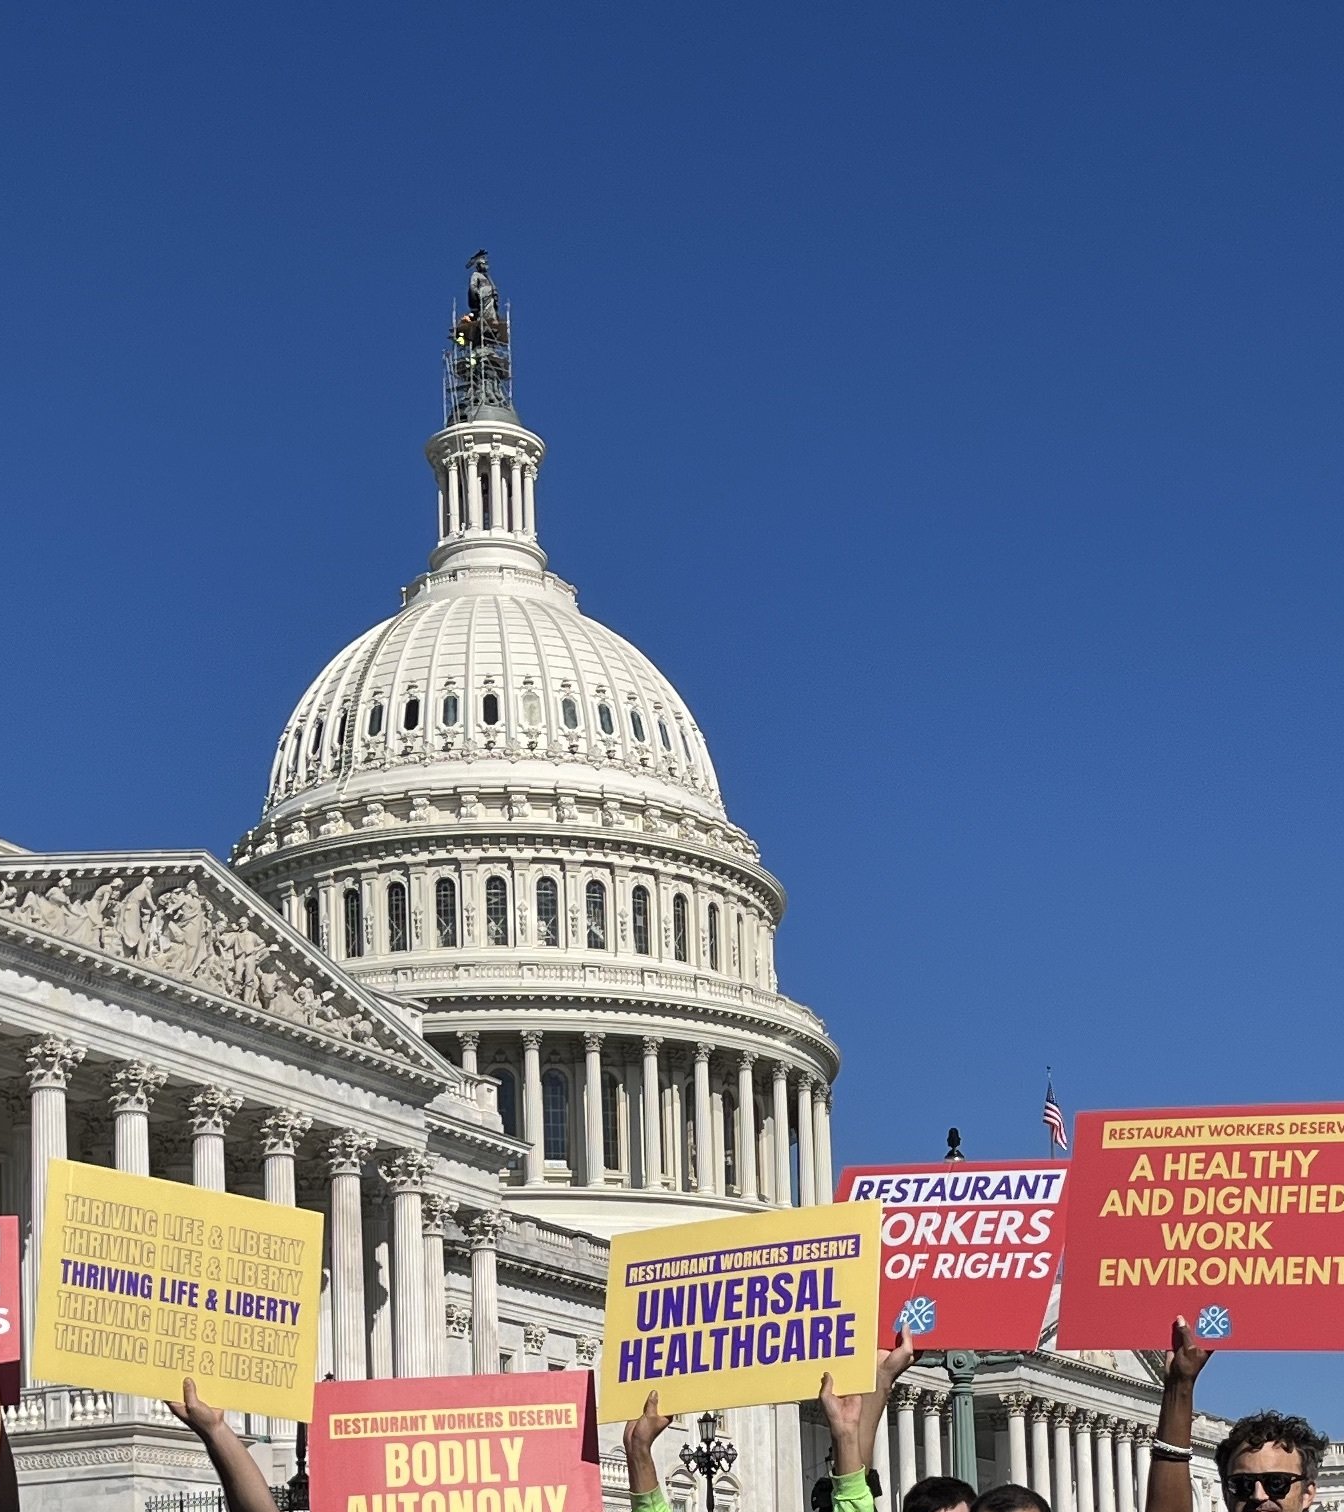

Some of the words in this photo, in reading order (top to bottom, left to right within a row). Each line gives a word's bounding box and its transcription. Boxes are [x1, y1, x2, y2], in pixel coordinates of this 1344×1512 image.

[1108, 1124, 1205, 1142] RESTAURANT
[1207, 1121, 1285, 1138] WORKERS
[855, 1173, 1061, 1203] RESTAURANT
[1128, 1153, 1155, 1182] A
[1163, 1149, 1320, 1182] HEALTHY
[1098, 1187, 1174, 1218] AND
[65, 1194, 158, 1238] THRIVING
[163, 1213, 205, 1247] LIFE
[208, 1225, 224, 1250] &
[228, 1226, 305, 1266] LIBERTY
[881, 1208, 1055, 1247] ORKERS
[1160, 1220, 1275, 1251] WORK
[62, 1225, 156, 1270] THRIVING
[160, 1245, 203, 1278] LIFE
[206, 1256, 221, 1281] &
[226, 1257, 303, 1297] LIBERTY
[629, 1255, 716, 1285] RESTAURANT
[720, 1246, 789, 1270] WORKERS
[792, 1238, 856, 1262] DESERVE
[884, 1252, 930, 1280] OF
[932, 1251, 1053, 1280] RIGHTS
[60, 1258, 153, 1301] THRIVING
[159, 1277, 200, 1309] LIFE
[204, 1288, 218, 1313] &
[224, 1288, 302, 1327] LIBERTY
[636, 1266, 842, 1333] UNIVERSAL
[57, 1290, 152, 1333] THRIVING
[156, 1307, 198, 1341] LIFE
[201, 1319, 217, 1344] &
[222, 1319, 300, 1359] LIBERTY
[618, 1312, 856, 1384] HEALTHCARE
[54, 1322, 148, 1365] THRIVING
[153, 1339, 196, 1373] LIFE
[199, 1351, 215, 1376] &
[219, 1351, 298, 1389] LIBERTY
[333, 1414, 427, 1436] RESTAURANT
[432, 1411, 504, 1431] WORKERS
[508, 1407, 573, 1428] DESERVE
[384, 1436, 524, 1488] BODILY
